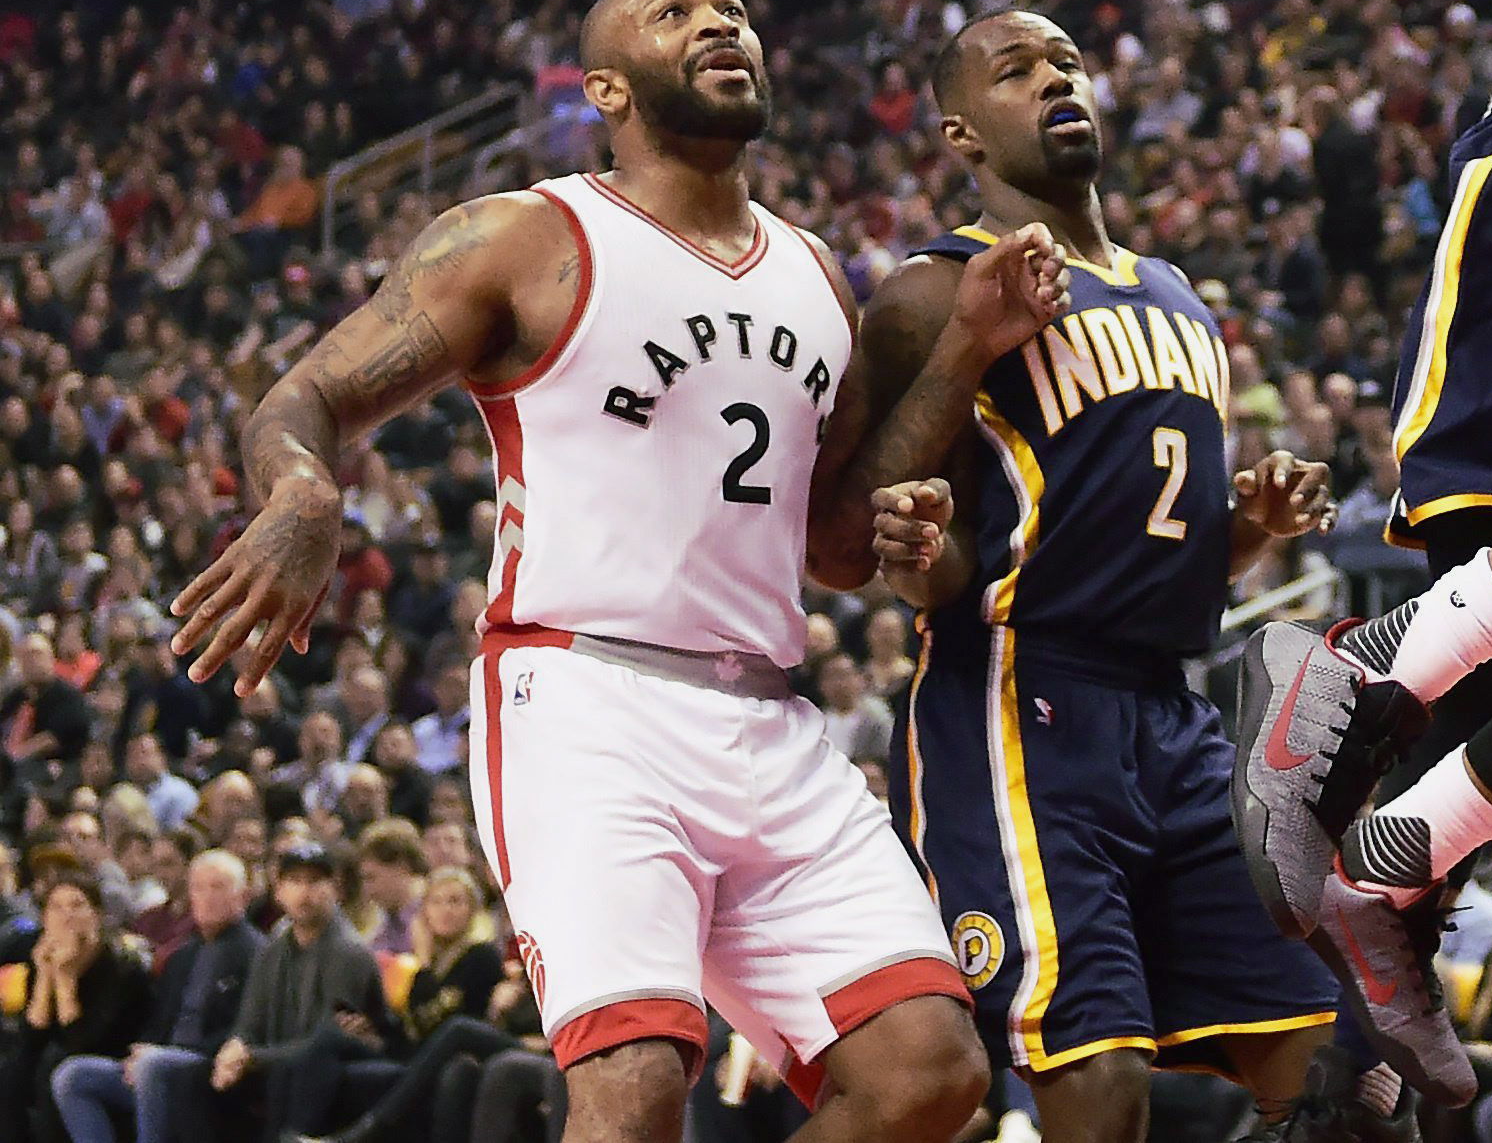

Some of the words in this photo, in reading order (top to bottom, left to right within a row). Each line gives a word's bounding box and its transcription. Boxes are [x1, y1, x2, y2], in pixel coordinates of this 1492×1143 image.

[1021, 304, 1231, 437] INDIAN
[719, 401, 772, 505] 2
[1146, 425, 1189, 541] 2
